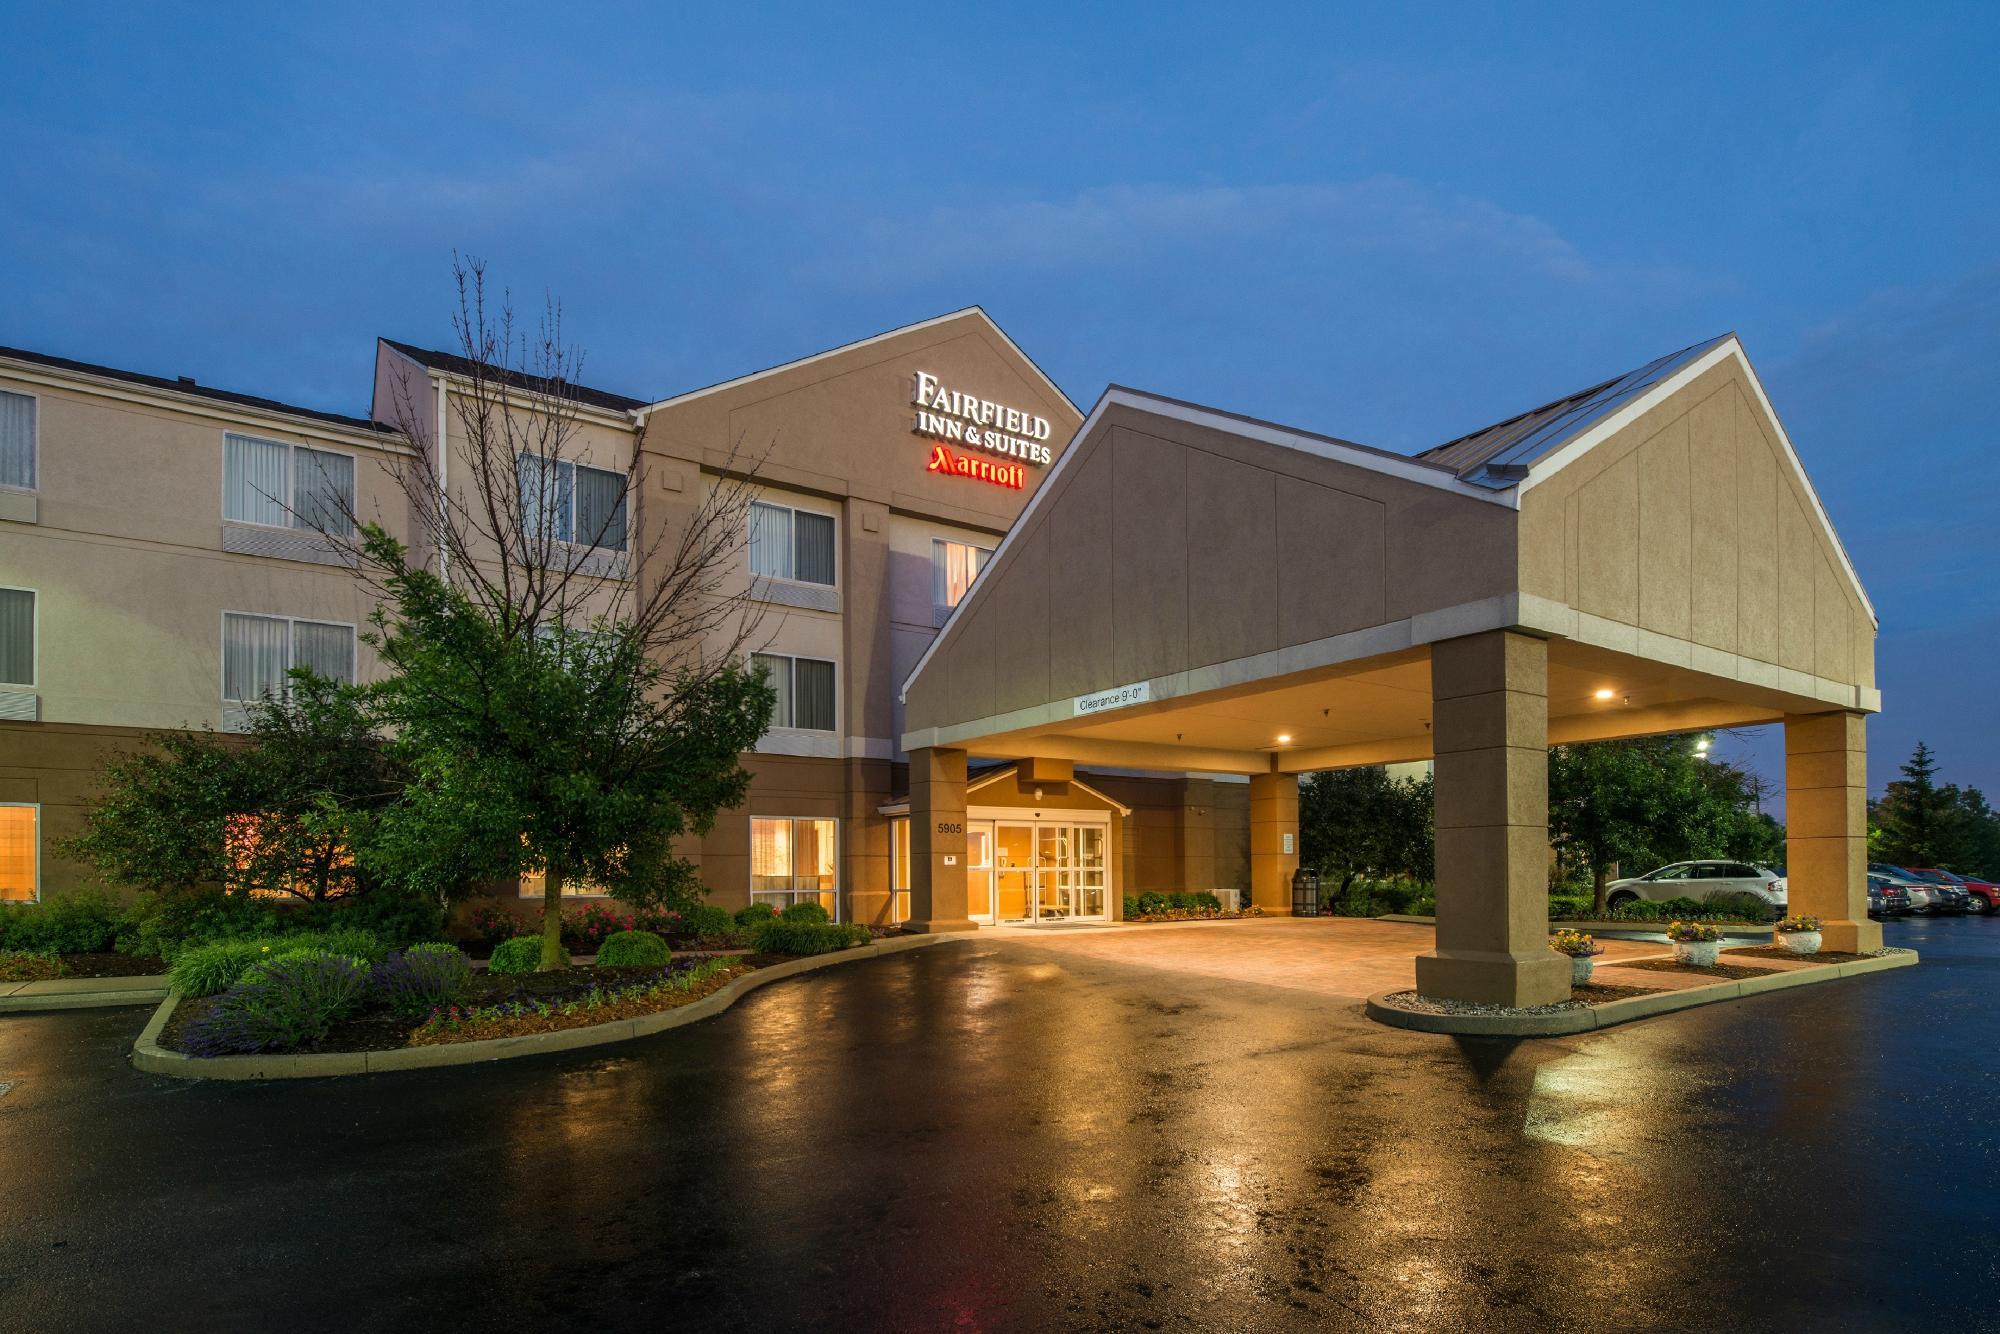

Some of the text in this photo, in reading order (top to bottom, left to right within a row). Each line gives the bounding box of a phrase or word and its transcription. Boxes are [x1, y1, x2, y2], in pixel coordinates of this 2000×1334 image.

[915, 371, 1050, 440] FAIRFIELD
[917, 411, 1051, 465] INN & SUITES
[928, 446, 1025, 489] Marriott
[1080, 695, 1119, 710] Clearance
[937, 823, 961, 833] 5905
